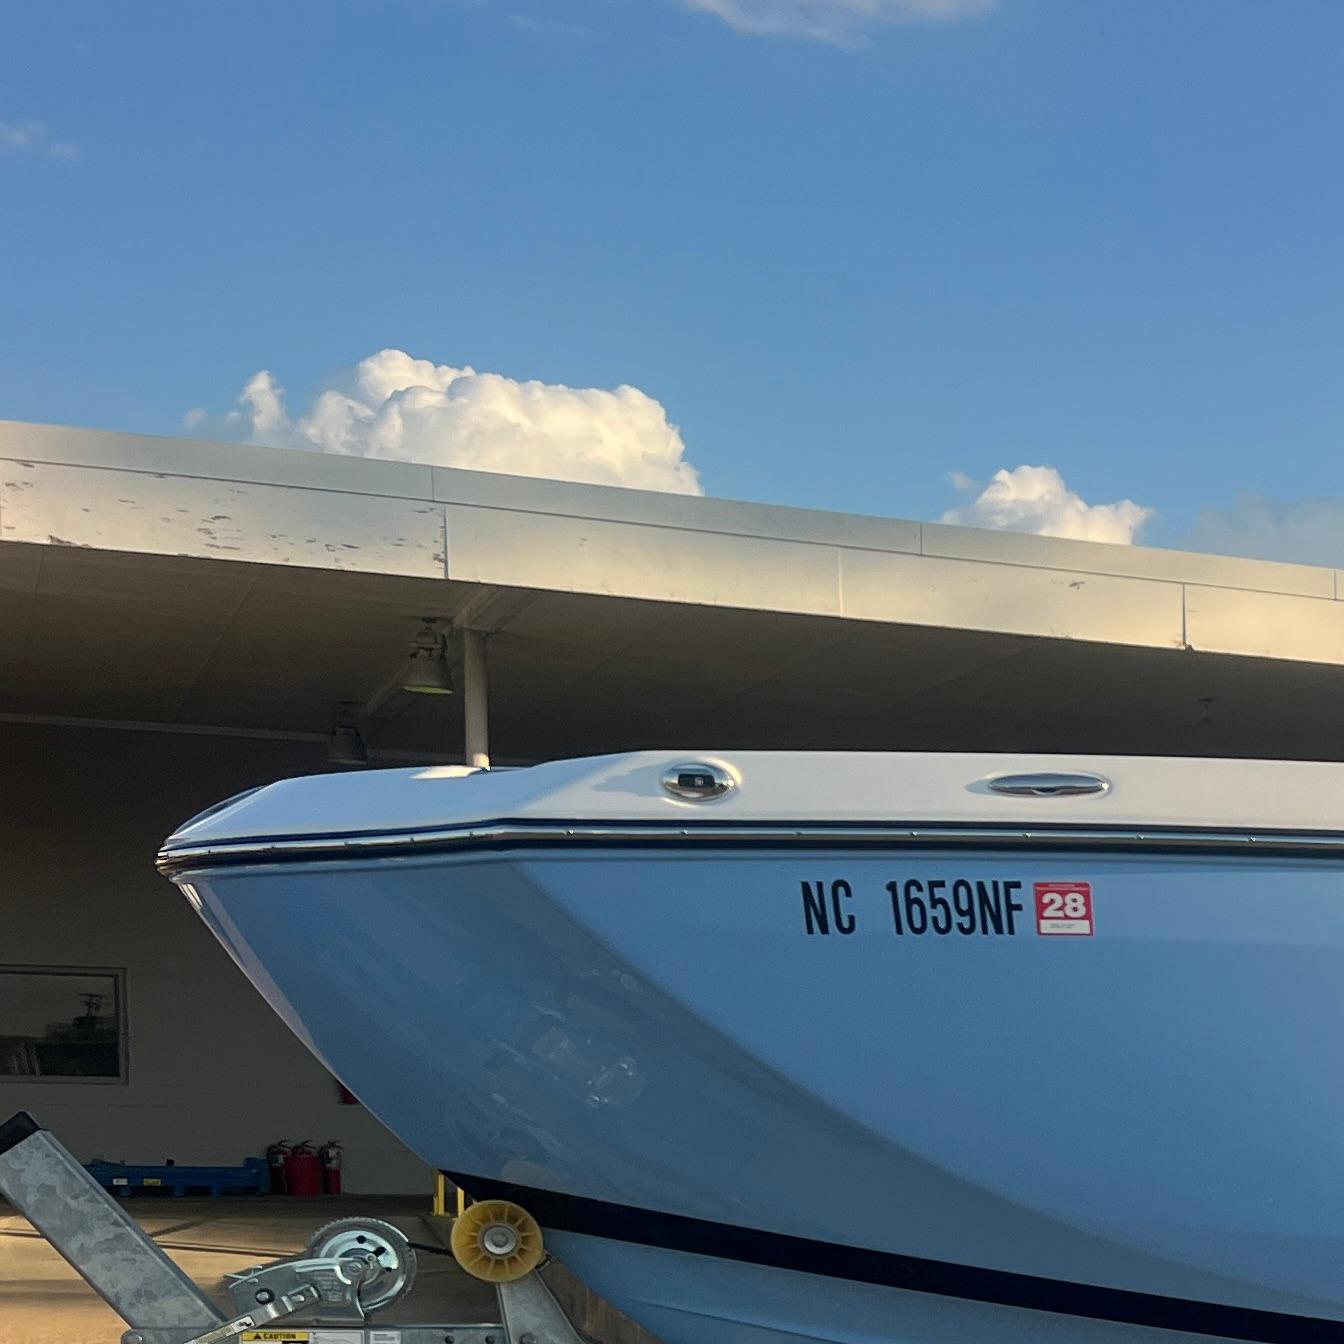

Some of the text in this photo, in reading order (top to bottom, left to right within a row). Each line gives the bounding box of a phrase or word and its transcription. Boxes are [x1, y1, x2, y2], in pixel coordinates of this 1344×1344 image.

[801, 879, 1024, 935] NC 1659NF
[1041, 892, 1087, 918] 28
